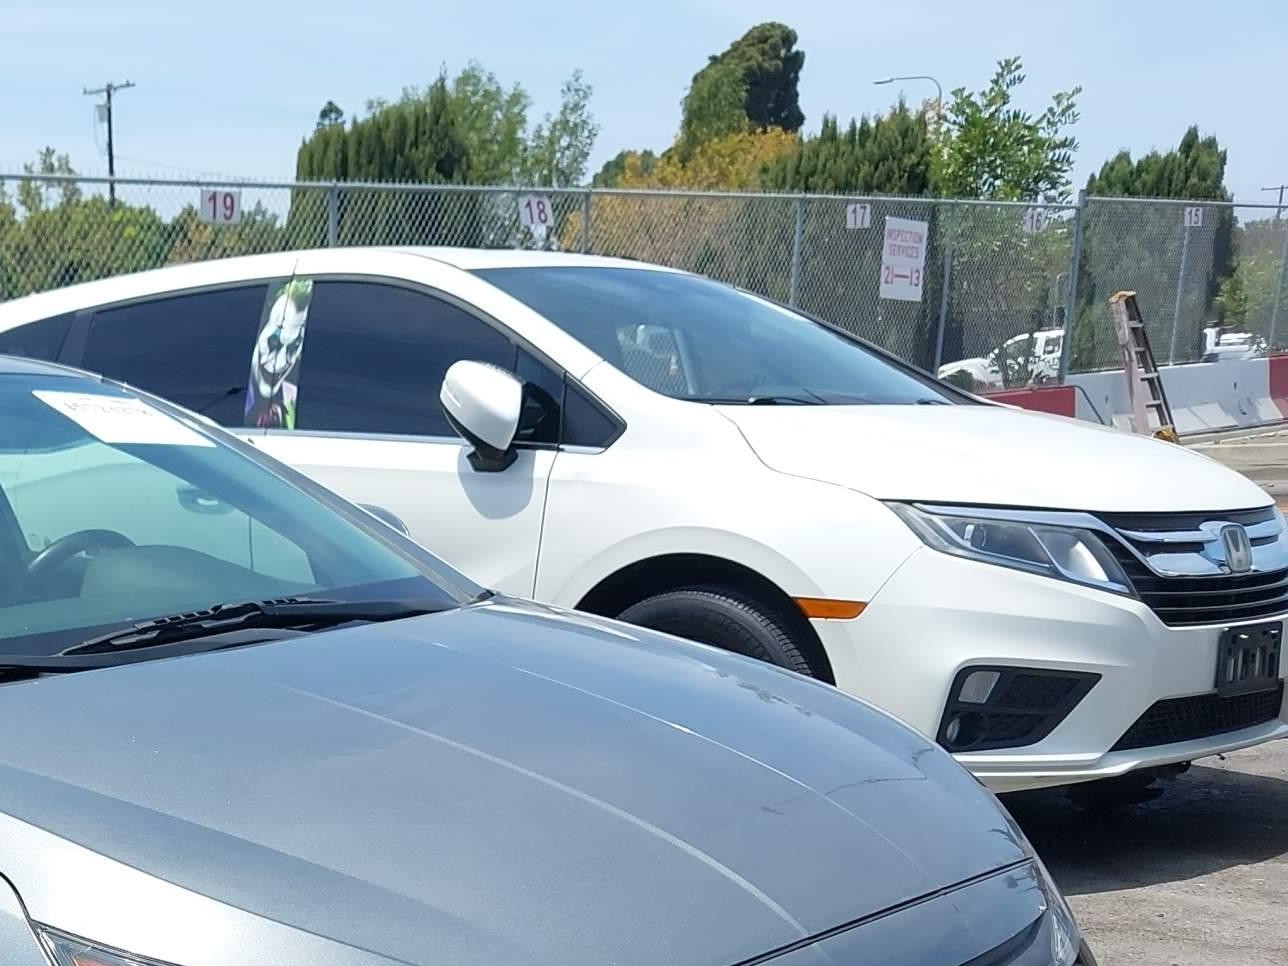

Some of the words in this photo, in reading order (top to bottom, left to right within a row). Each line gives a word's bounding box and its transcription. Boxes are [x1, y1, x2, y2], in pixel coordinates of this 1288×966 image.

[208, 191, 235, 221] 19
[525, 200, 548, 224] 18
[851, 204, 867, 227] 17
[1187, 207, 1201, 225] 15
[1029, 212, 1042, 231] 16
